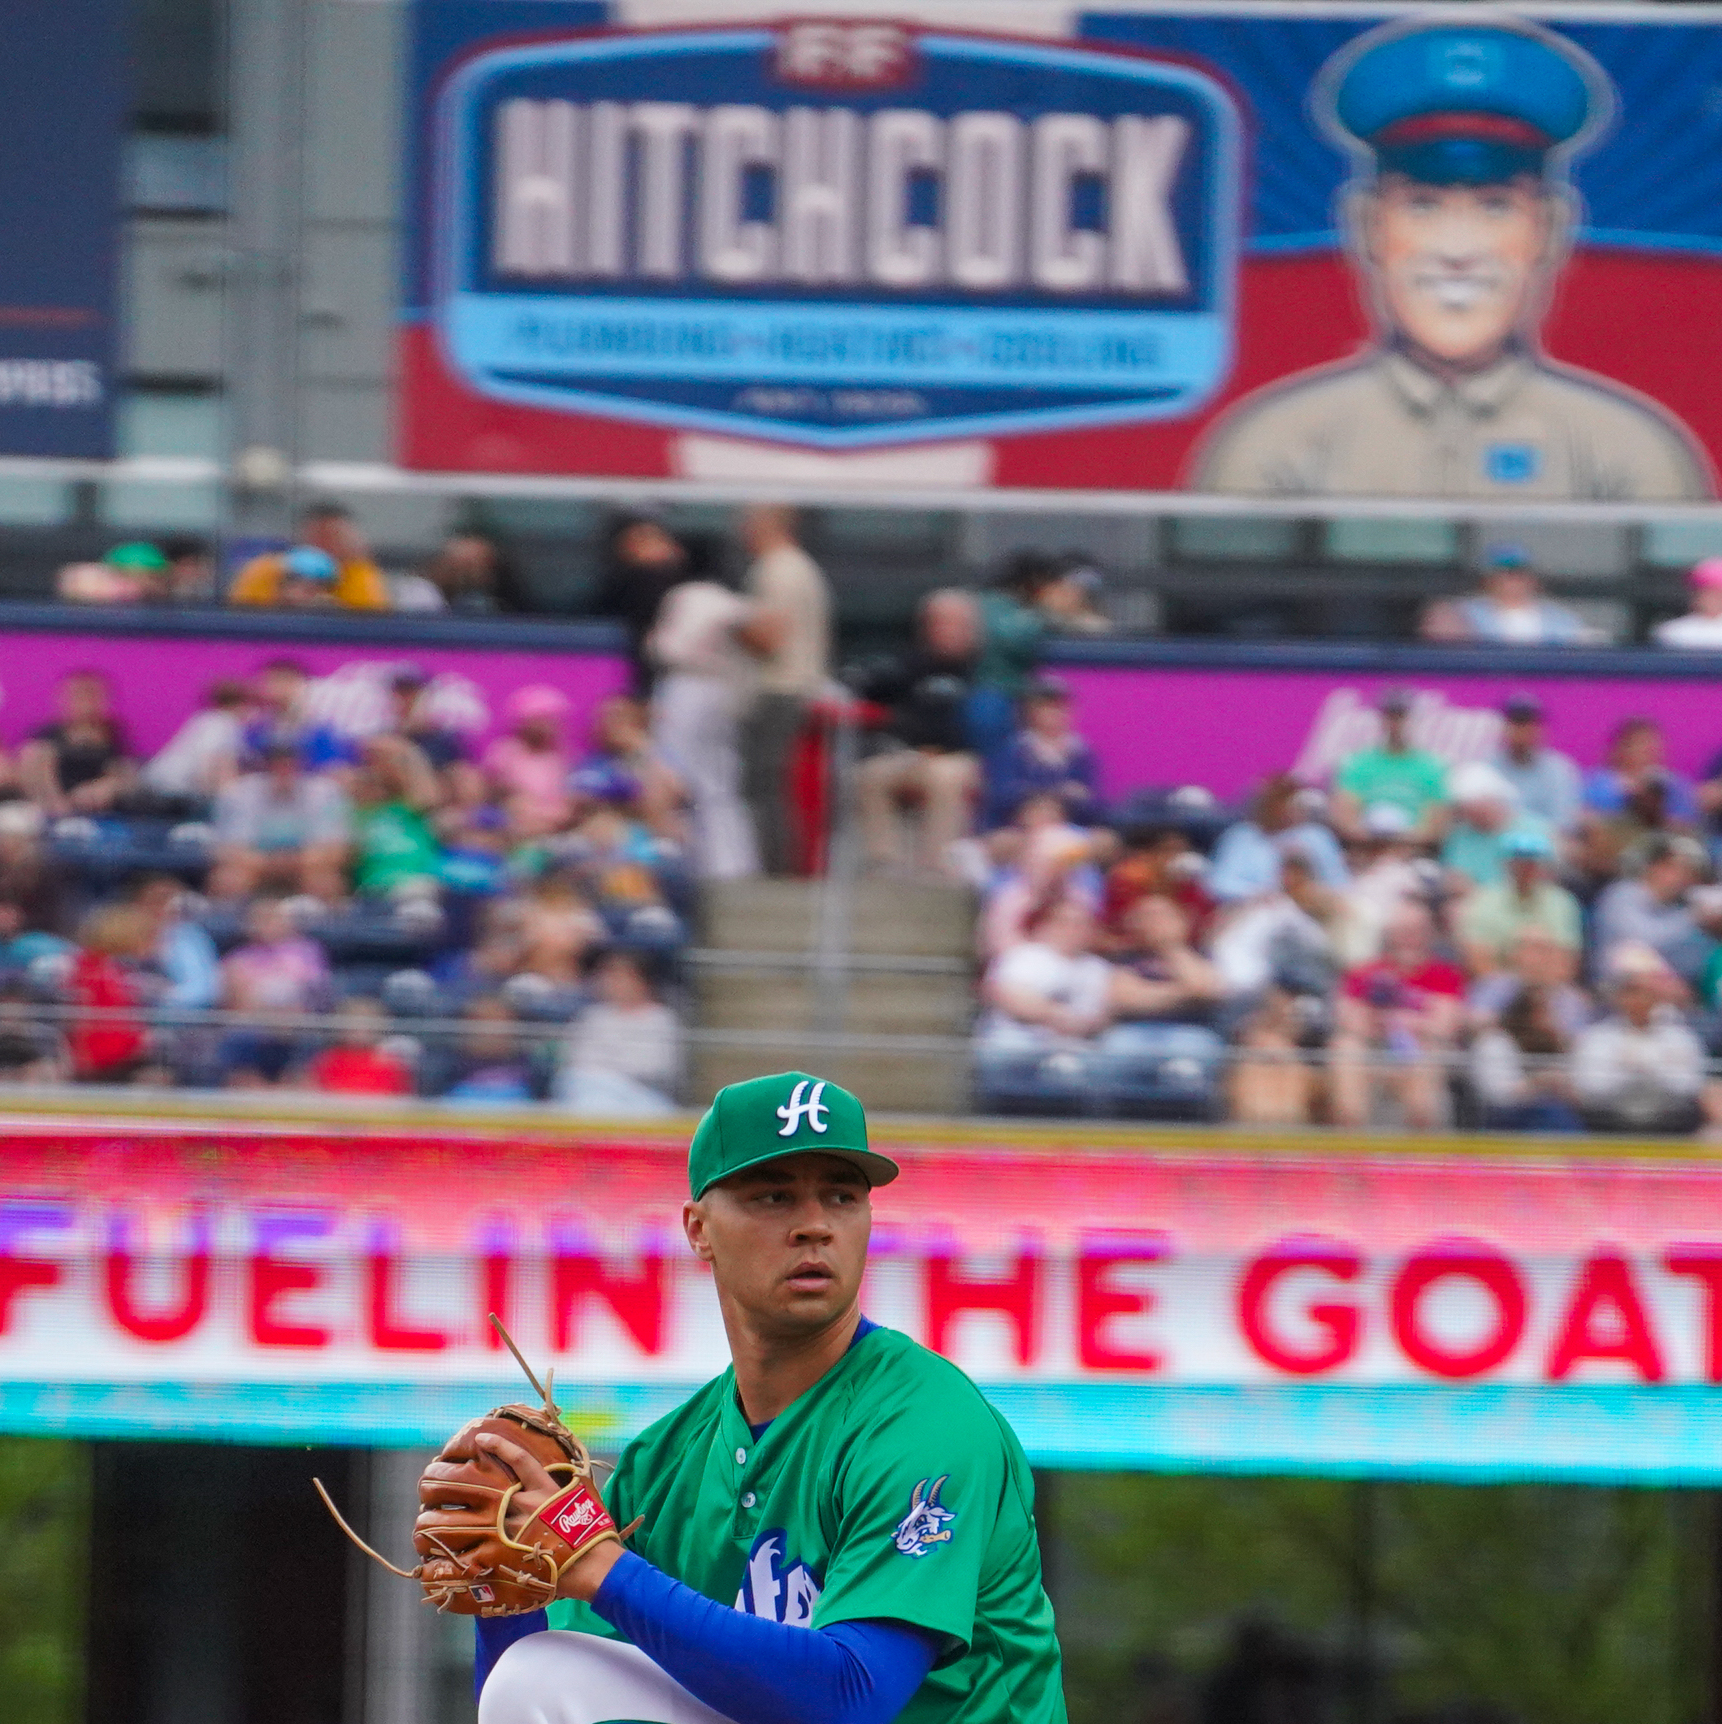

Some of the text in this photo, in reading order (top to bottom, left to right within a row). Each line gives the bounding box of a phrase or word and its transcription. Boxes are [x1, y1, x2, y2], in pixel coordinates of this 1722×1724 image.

[493, 97, 1193, 294] HITCHCOCK
[776, 1080, 830, 1137] H
[869, 1225, 1171, 1376] HE
